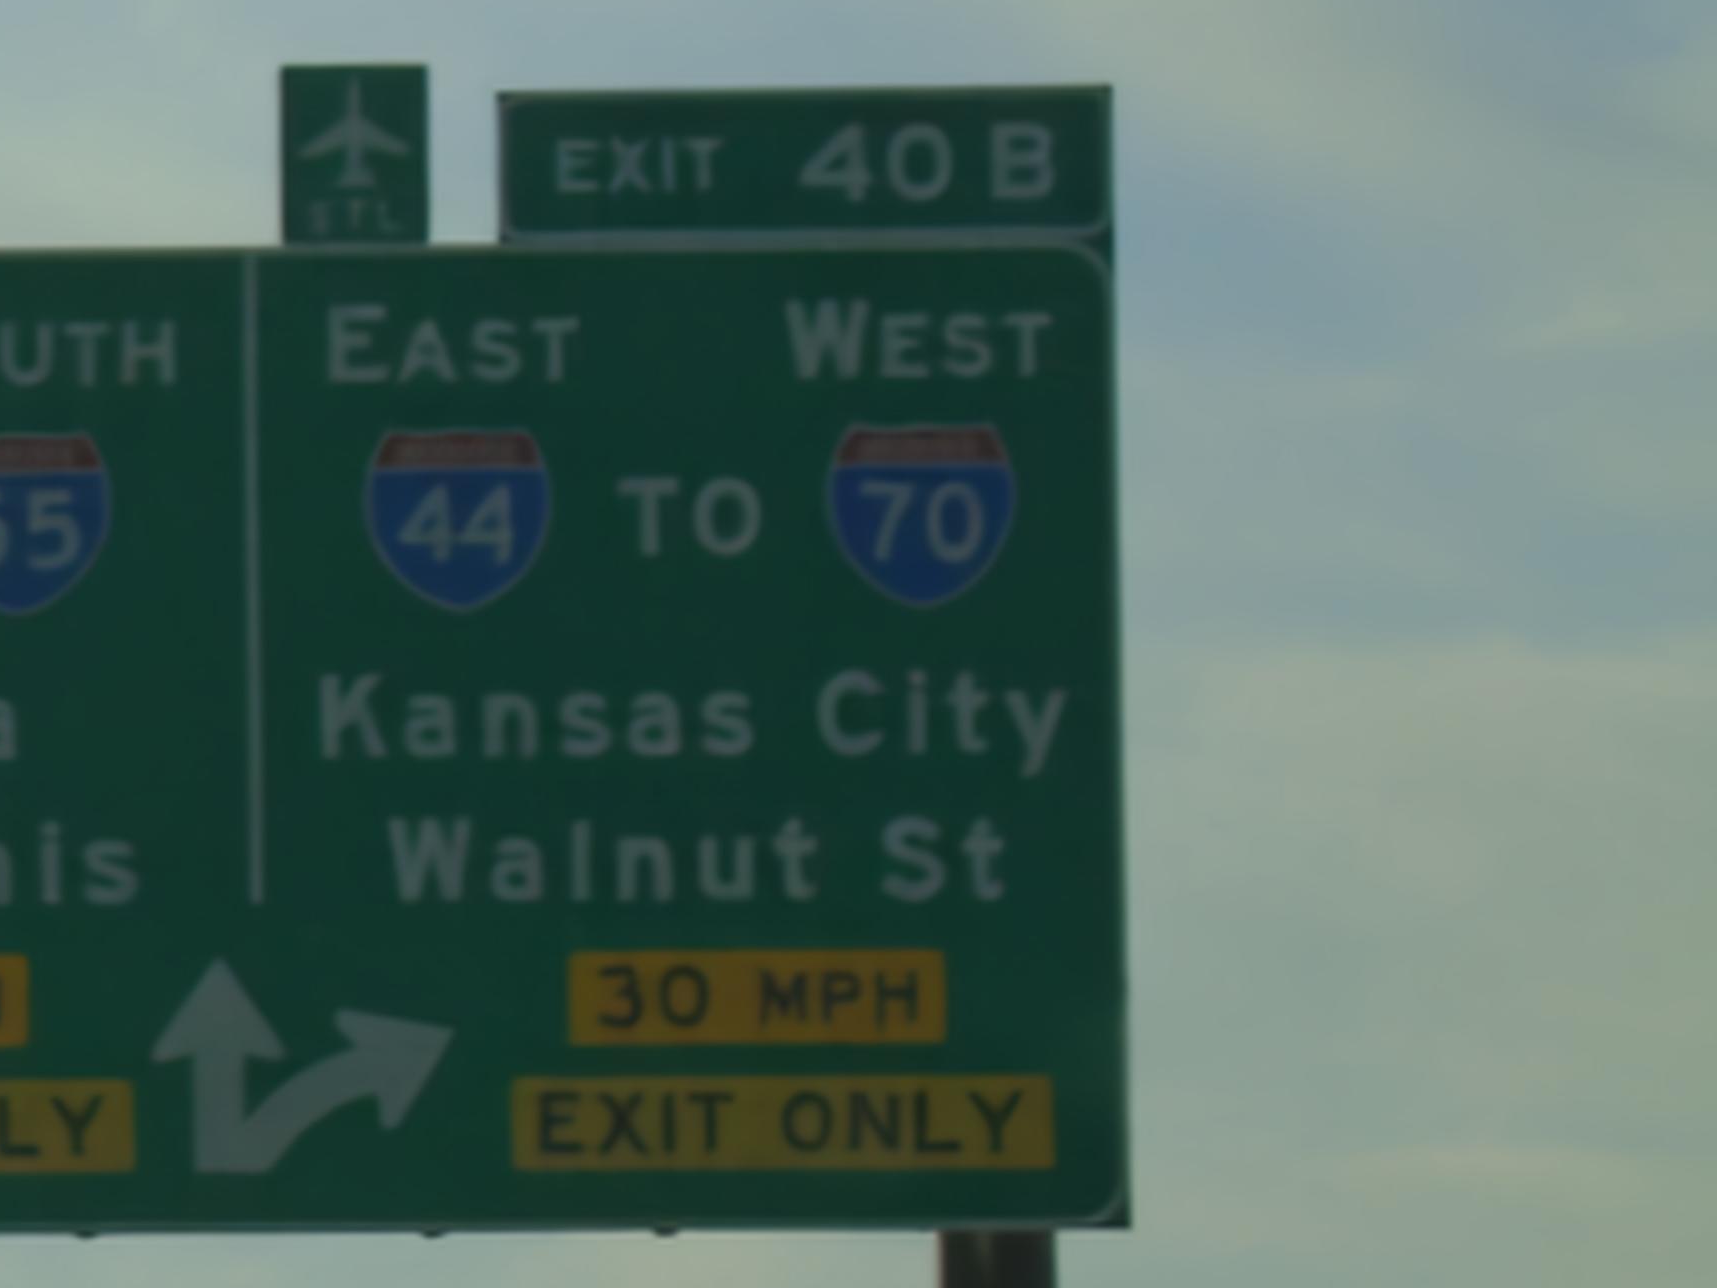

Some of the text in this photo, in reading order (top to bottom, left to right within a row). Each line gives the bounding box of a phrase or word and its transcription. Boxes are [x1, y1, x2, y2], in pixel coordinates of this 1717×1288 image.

[554, 122, 1058, 203] EXIT 40 B
[327, 303, 580, 385] EAST
[786, 299, 1054, 380] WEST
[397, 482, 515, 567] 44
[617, 477, 763, 558] TO
[860, 479, 985, 566] 70
[318, 668, 1068, 780] Kansas City
[387, 815, 1006, 905] Walnut St
[596, 965, 922, 1030] 30 MPH
[536, 1090, 1026, 1157] EXIT ONLY
